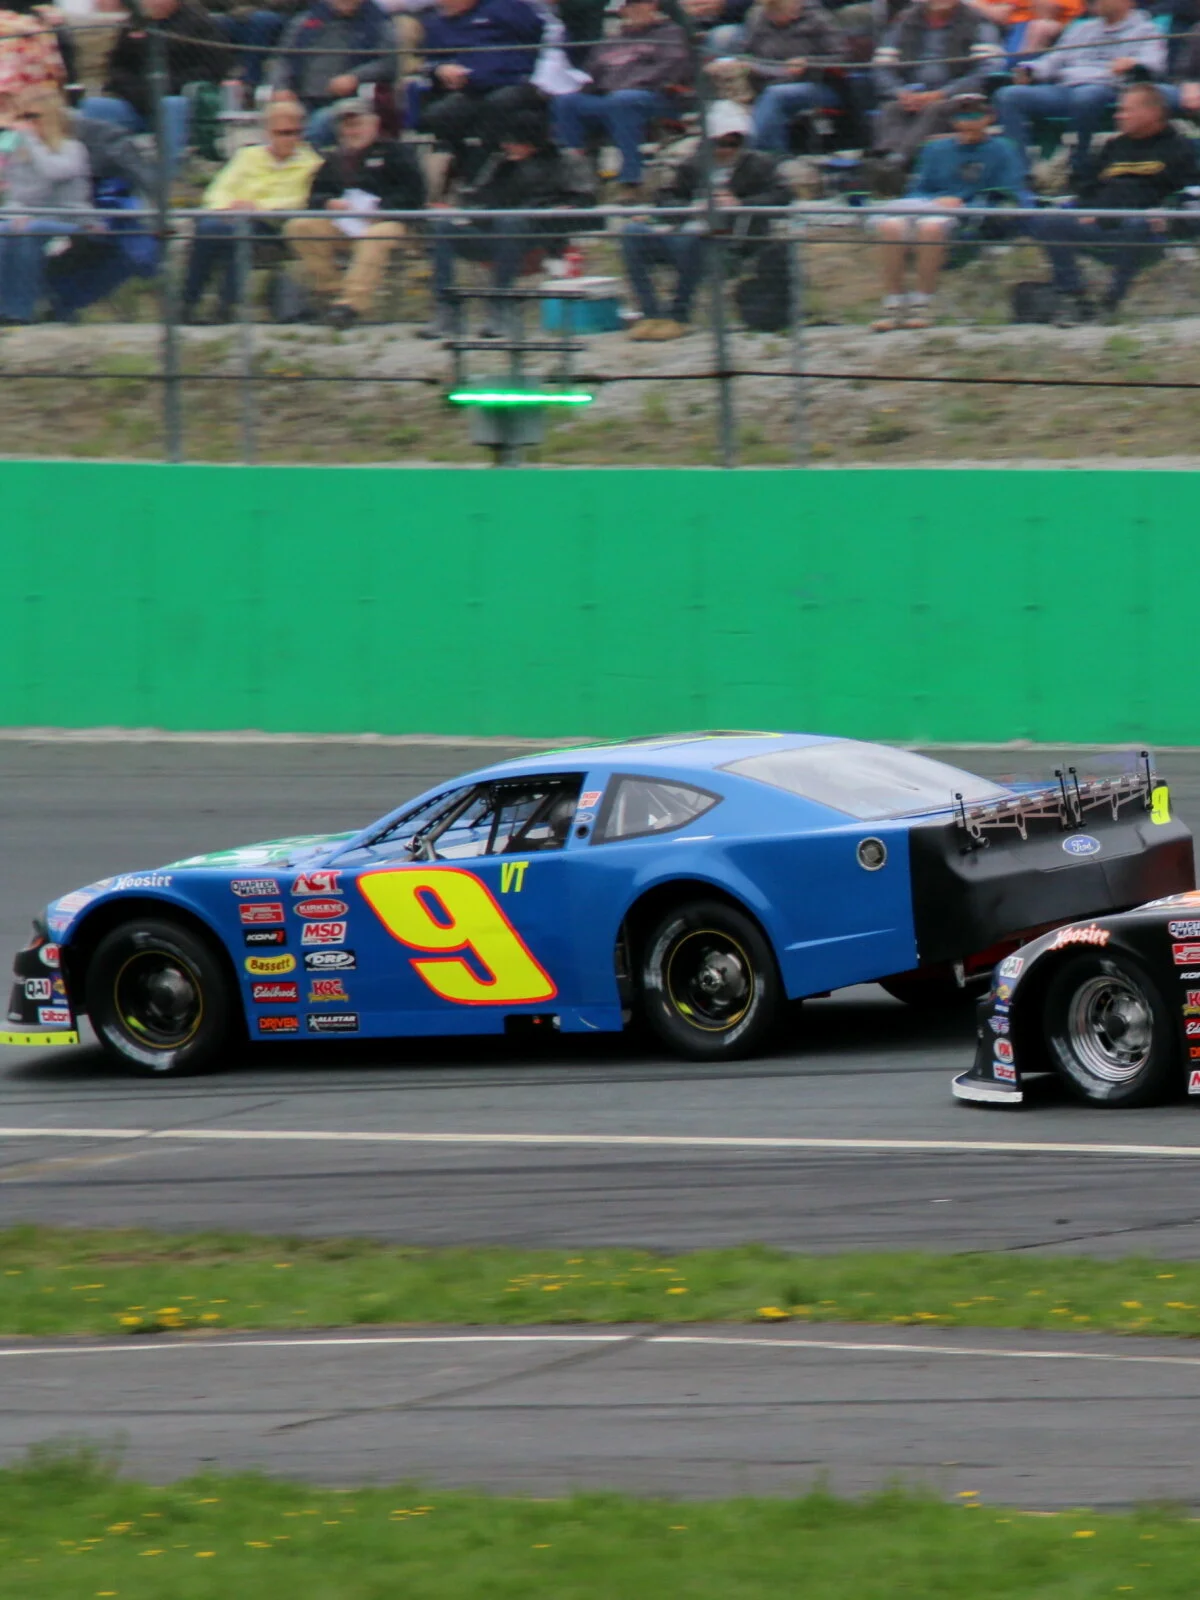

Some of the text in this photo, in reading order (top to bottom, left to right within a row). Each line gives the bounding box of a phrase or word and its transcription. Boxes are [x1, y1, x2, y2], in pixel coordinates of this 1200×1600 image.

[112, 873, 172, 891] Hoosier
[293, 871, 342, 892] ACT
[500, 861, 528, 893] VT
[231, 880, 274, 891] QUARTER
[240, 887, 277, 895] MASTER
[246, 933, 277, 941] KONI
[304, 923, 343, 938] MSD
[356, 866, 558, 1006] 9
[1048, 923, 1110, 950] Hoosier
[250, 958, 290, 971] Bassett
[312, 955, 349, 964] DRP
[26, 981, 49, 997] QA1
[254, 986, 296, 998] Edelbrock
[312, 980, 343, 996] KRC
[260, 1017, 298, 1030] DRIVEN
